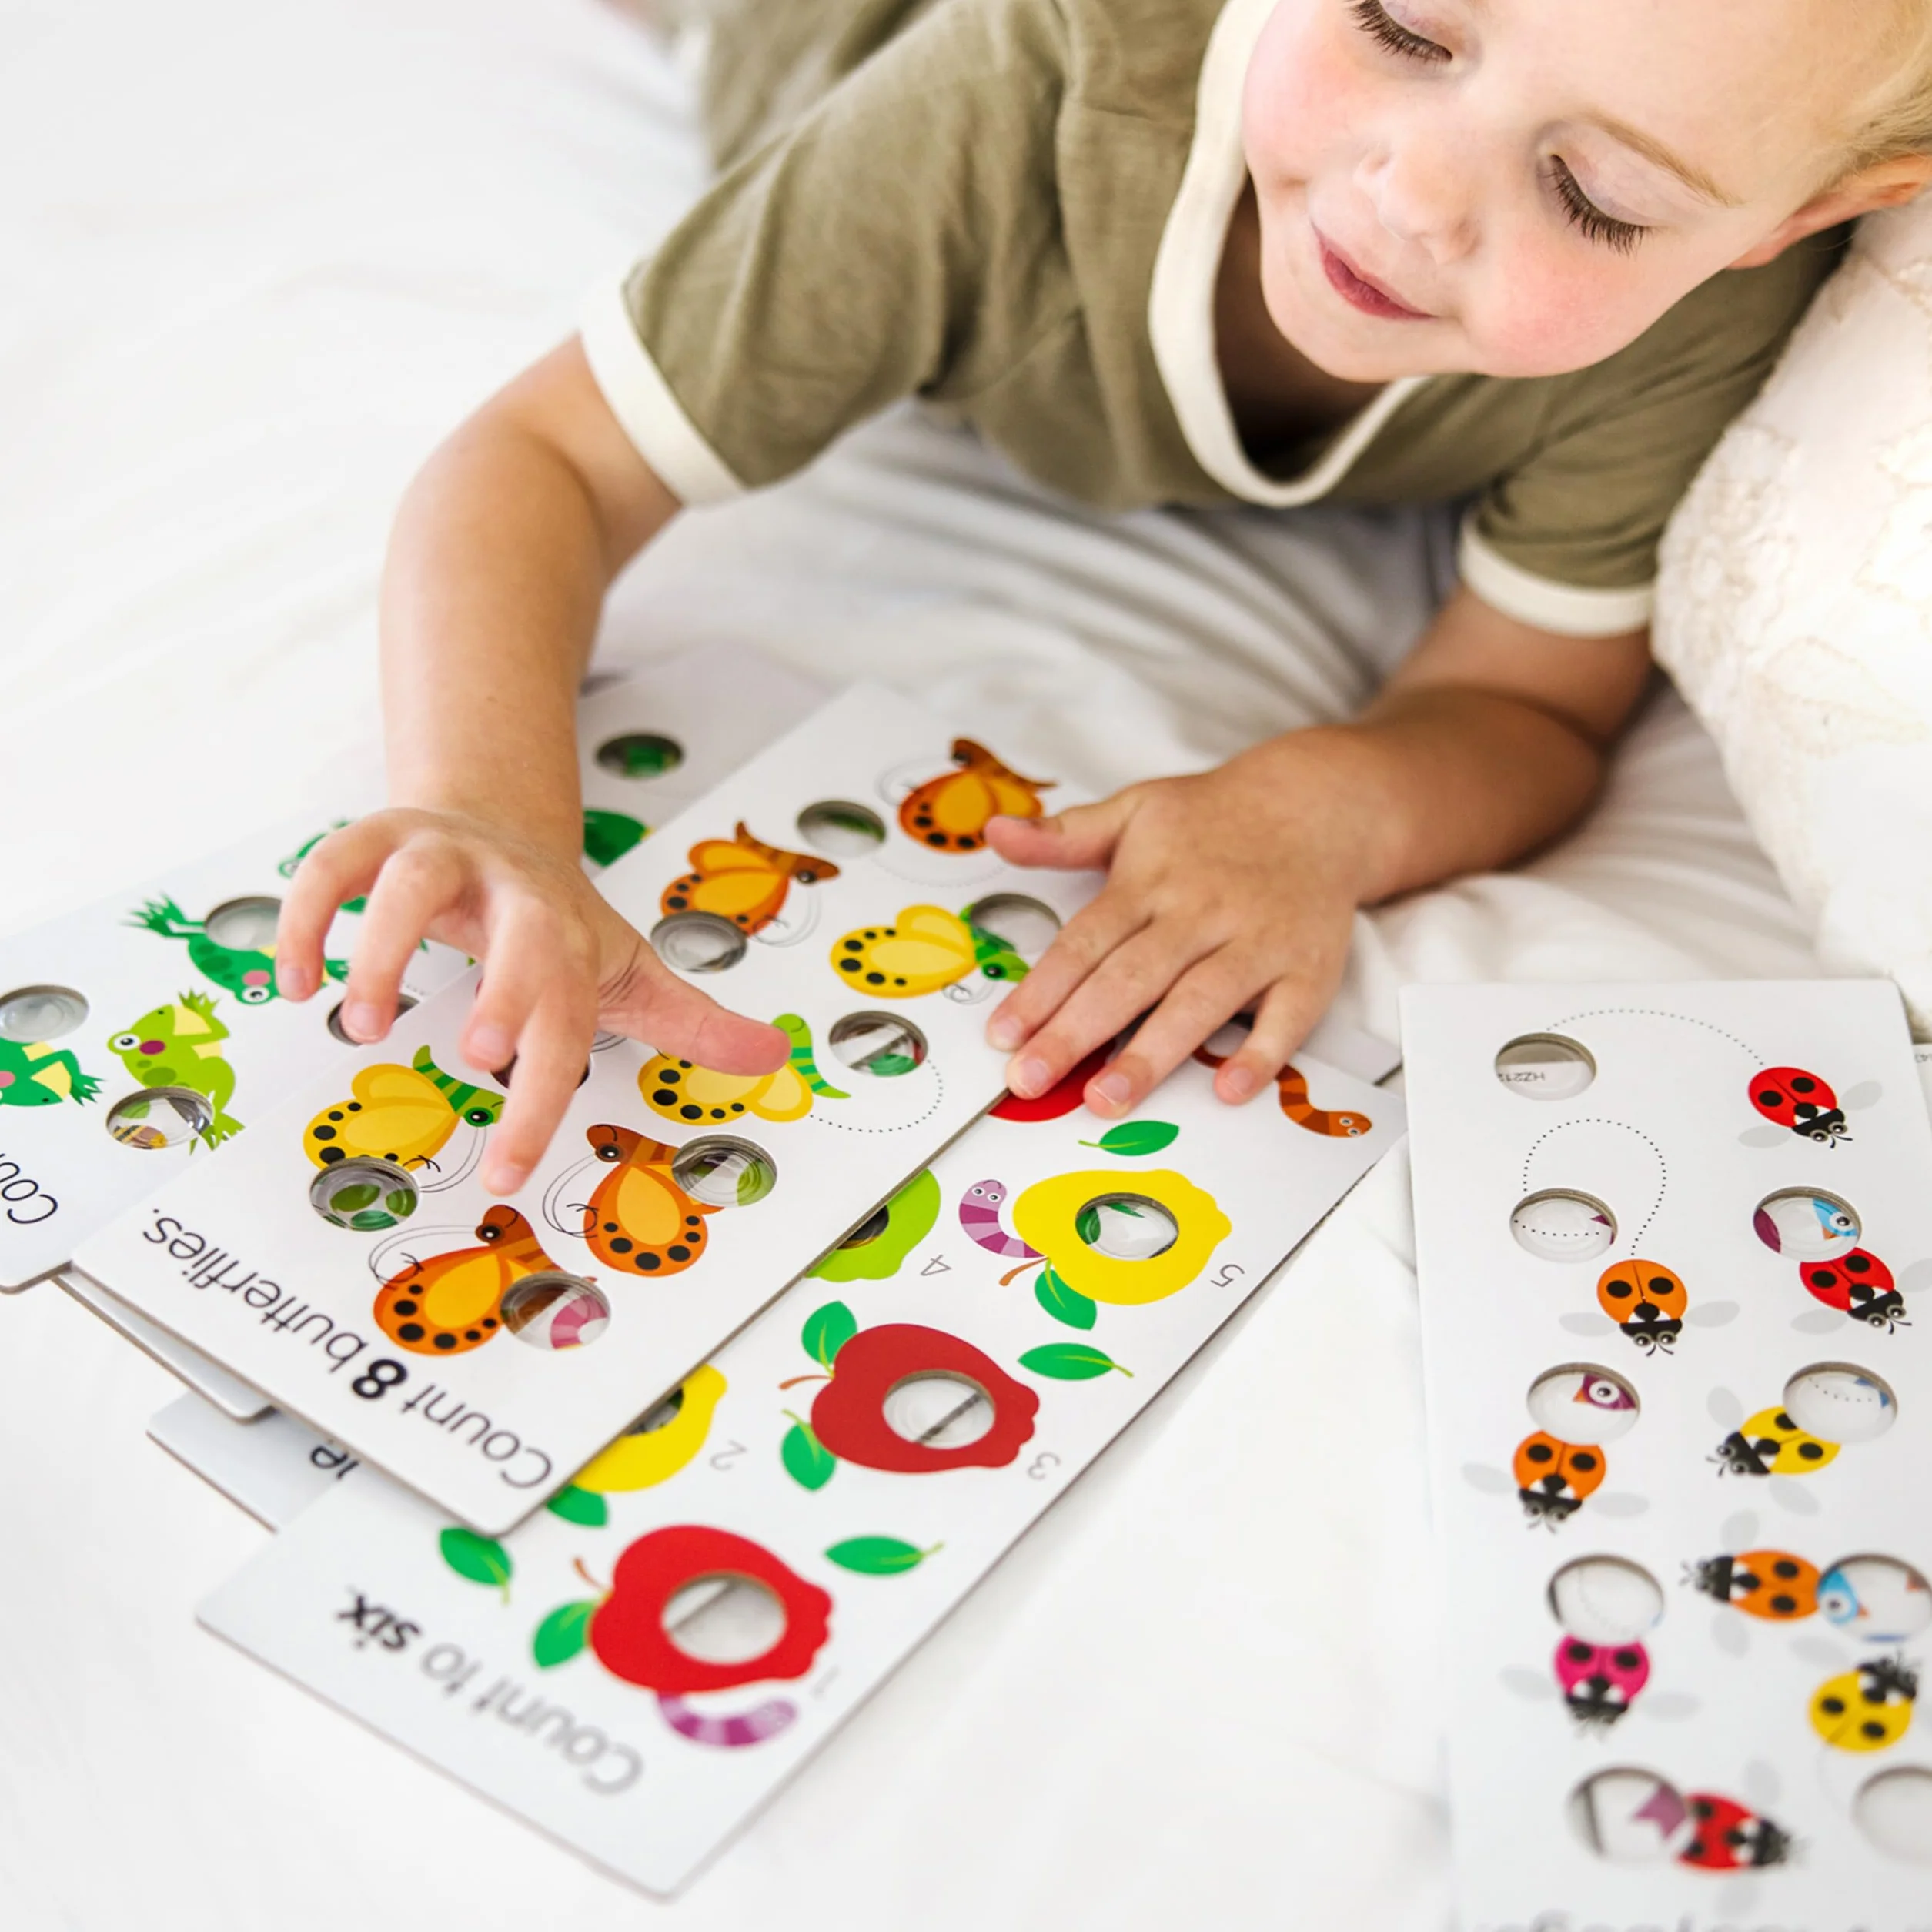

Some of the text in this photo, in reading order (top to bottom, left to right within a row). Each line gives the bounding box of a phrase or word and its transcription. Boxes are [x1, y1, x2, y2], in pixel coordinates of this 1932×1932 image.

[0, 1154, 58, 1224] Cou
[921, 1255, 952, 1277] 4
[1211, 1263, 1245, 1289] 5
[143, 1209, 552, 1488] Count 8 butterflies.
[710, 1439, 748, 1470] 2
[1026, 1452, 1061, 1481] 3
[420, 1643, 483, 1696] to
[470, 1677, 644, 1797] Count
